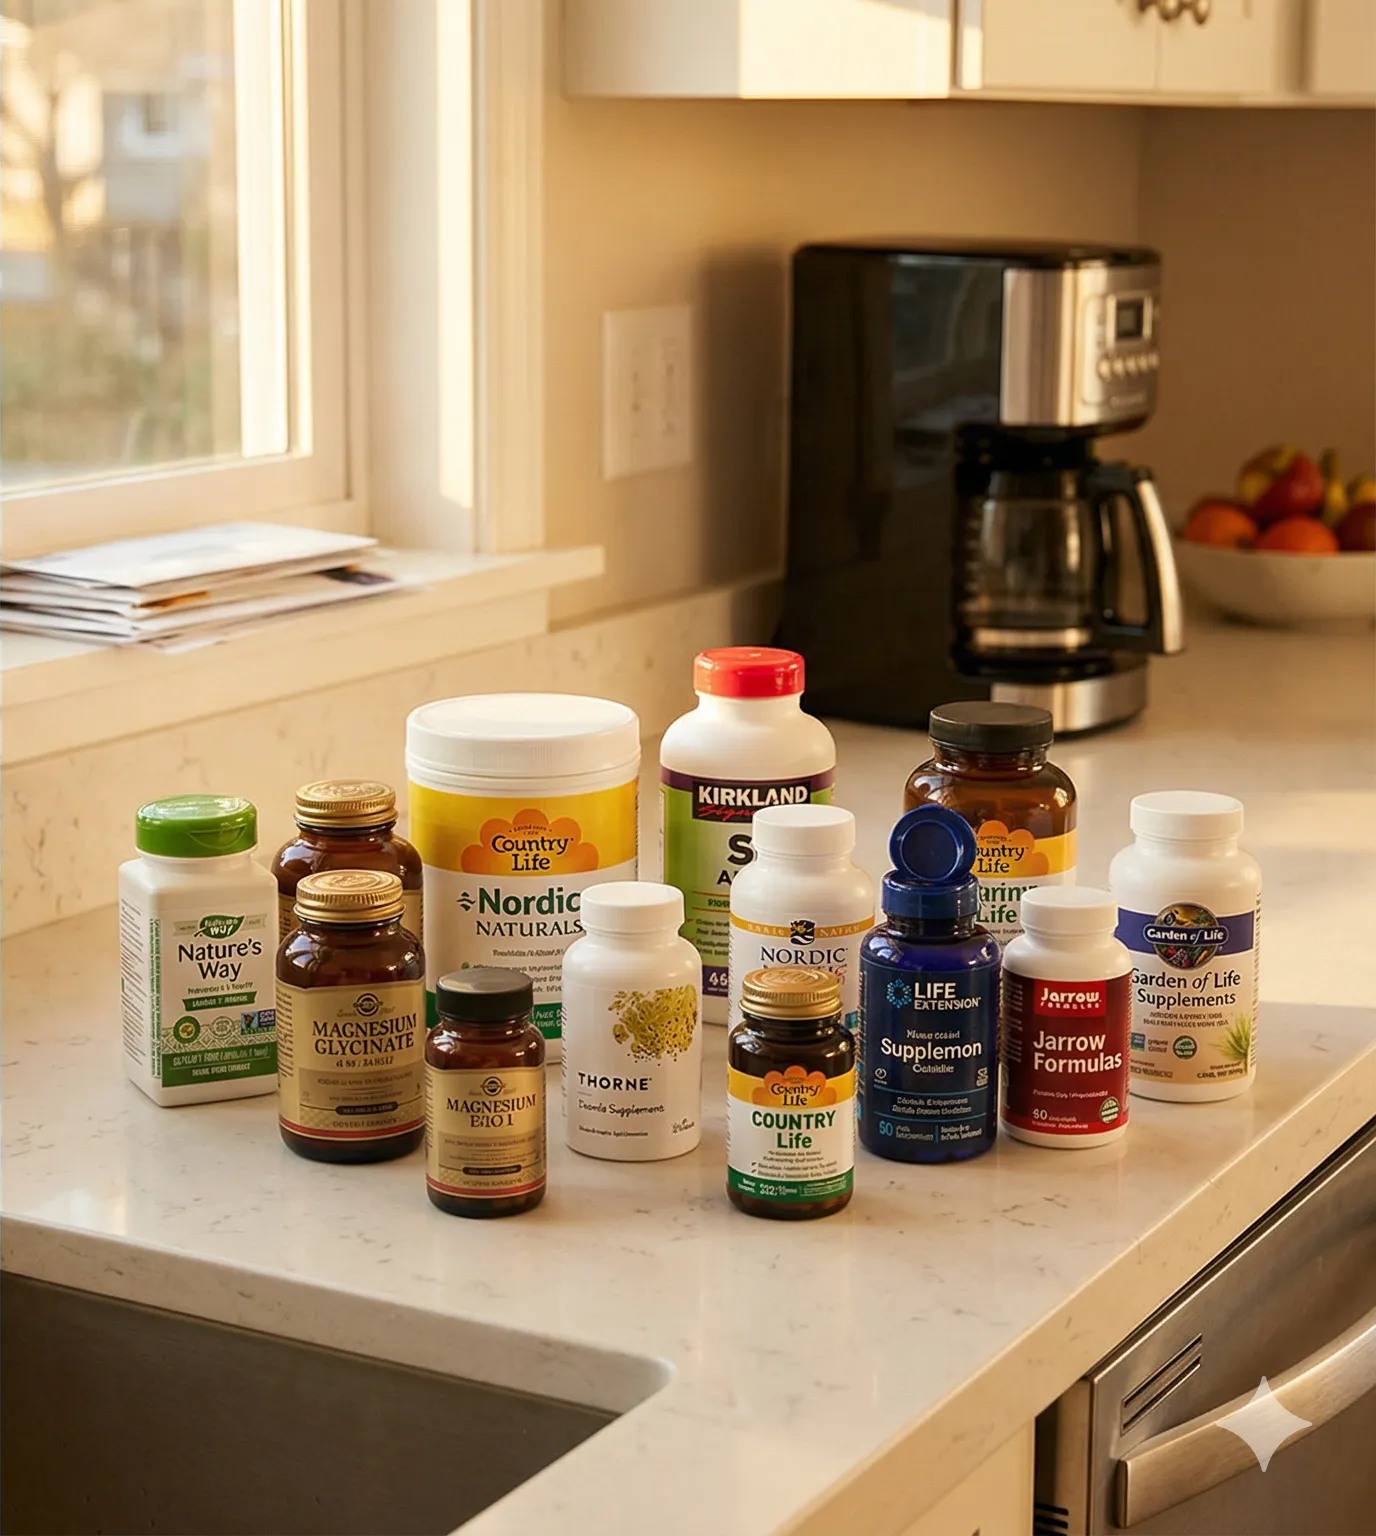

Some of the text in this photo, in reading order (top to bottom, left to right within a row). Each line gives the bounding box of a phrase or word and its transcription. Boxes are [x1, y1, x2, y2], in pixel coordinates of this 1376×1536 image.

[699, 786, 808, 806] KIRKLAND
[492, 835, 570, 855] Country
[976, 845, 1025, 861] untry
[511, 853, 551, 871] Life
[977, 858, 1010, 873] Life
[479, 887, 581, 915] Nordic
[976, 904, 1018, 923] Life
[476, 919, 584, 937] NATURALS
[178, 938, 262, 962] Nature's
[761, 947, 846, 965] NORDIC
[197, 961, 242, 982] Way
[1132, 968, 1241, 992] Garden of Life
[915, 983, 956, 999] LIFE
[1041, 988, 1100, 1003] Jarrow
[1137, 988, 1236, 1010] Supplements
[914, 997, 979, 1011] EXTENSION
[312, 1013, 417, 1038] MAGNESIUM
[315, 1032, 414, 1056] GLYCINATE
[881, 1038, 982, 1063] Supplemon
[1033, 1031, 1106, 1051] Jarrow
[1034, 1052, 1122, 1073] Formulas
[578, 1072, 649, 1091] THORNE
[447, 1094, 536, 1113] MAGNESIUM
[752, 1111, 836, 1130] COUNTRY
[777, 1133, 812, 1149] Life
